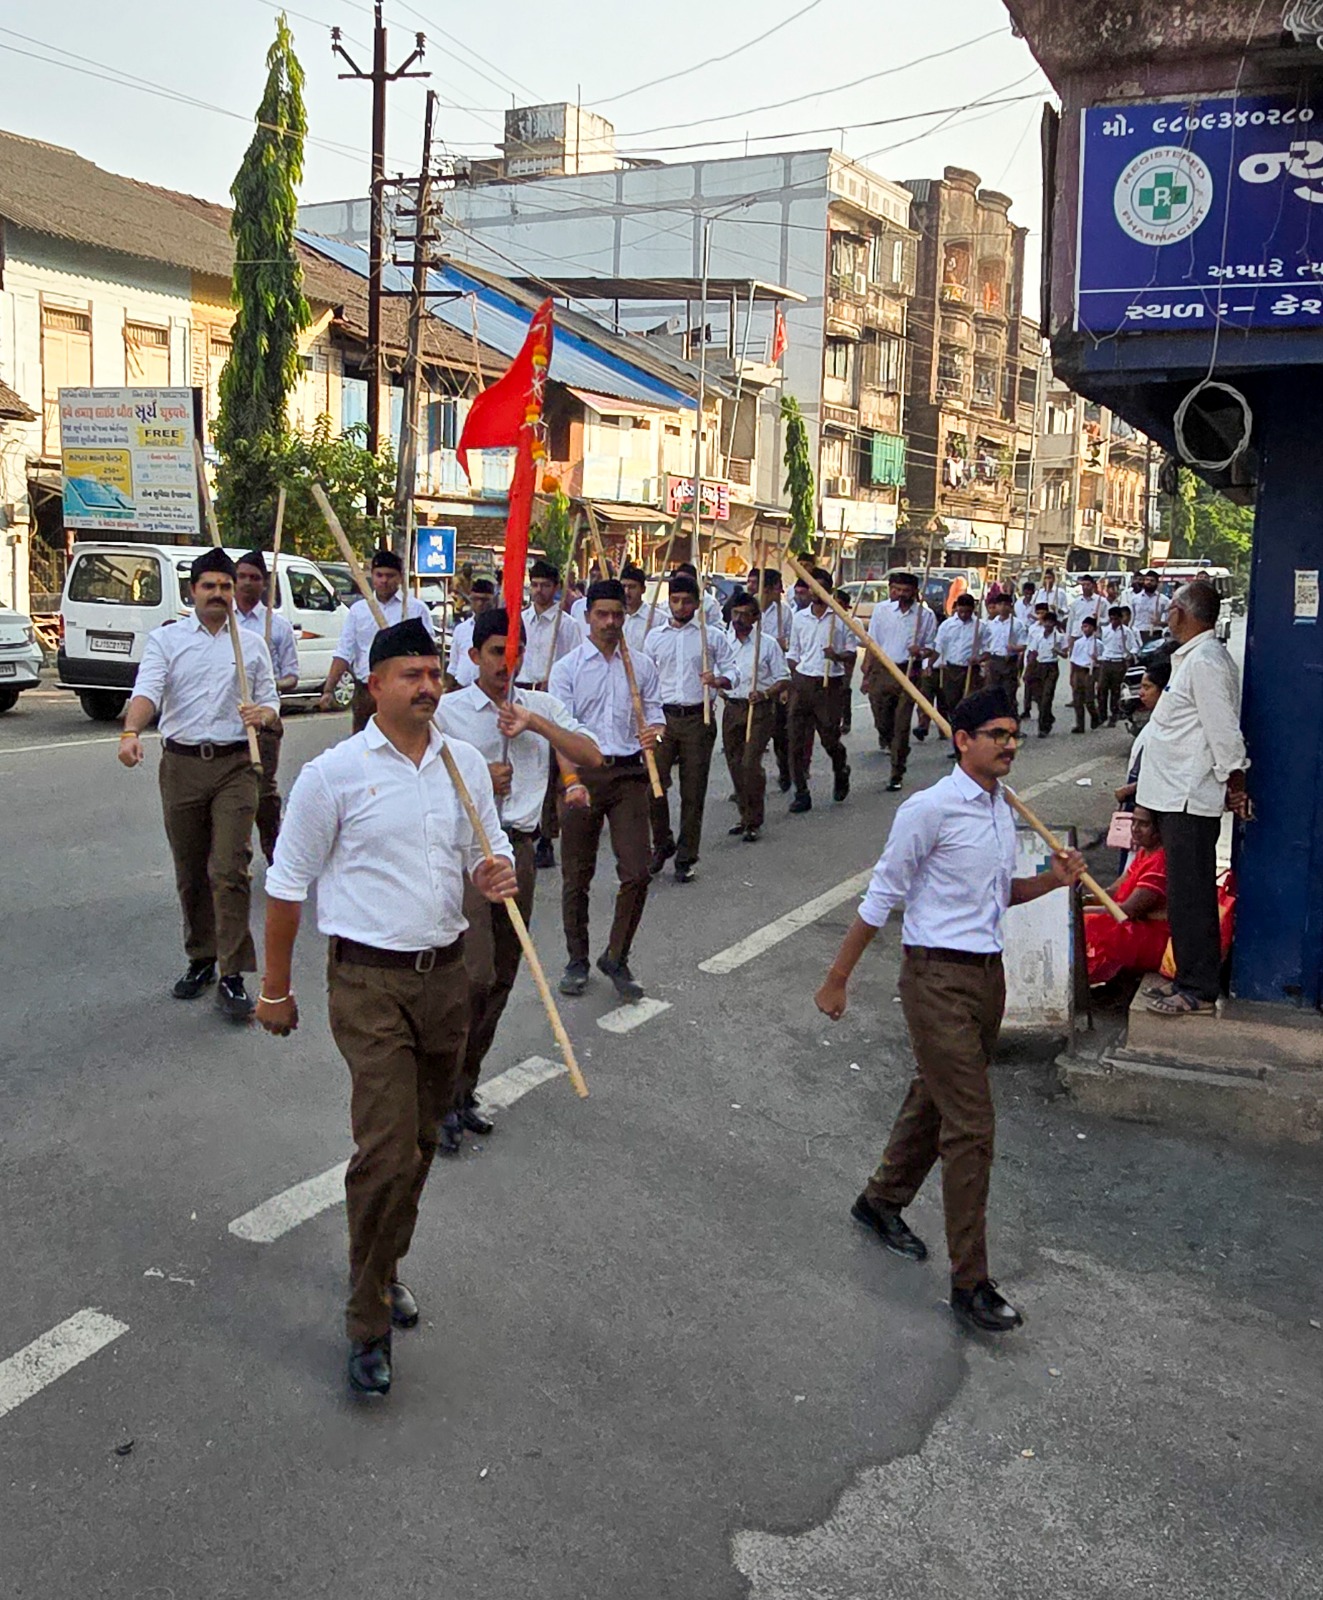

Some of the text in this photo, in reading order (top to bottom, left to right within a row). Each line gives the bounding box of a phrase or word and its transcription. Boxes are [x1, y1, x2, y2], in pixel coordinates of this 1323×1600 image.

[1102, 113, 1134, 136] મો.
[1123, 149, 1205, 184] REGISTERED
[1122, 207, 1204, 241] PHARMACIST
[1207, 257, 1284, 279] અમારે
[1124, 302, 1204, 320] સ્થળ
[134, 399, 157, 424] સૂર્ય
[144, 429, 180, 438] FREE
